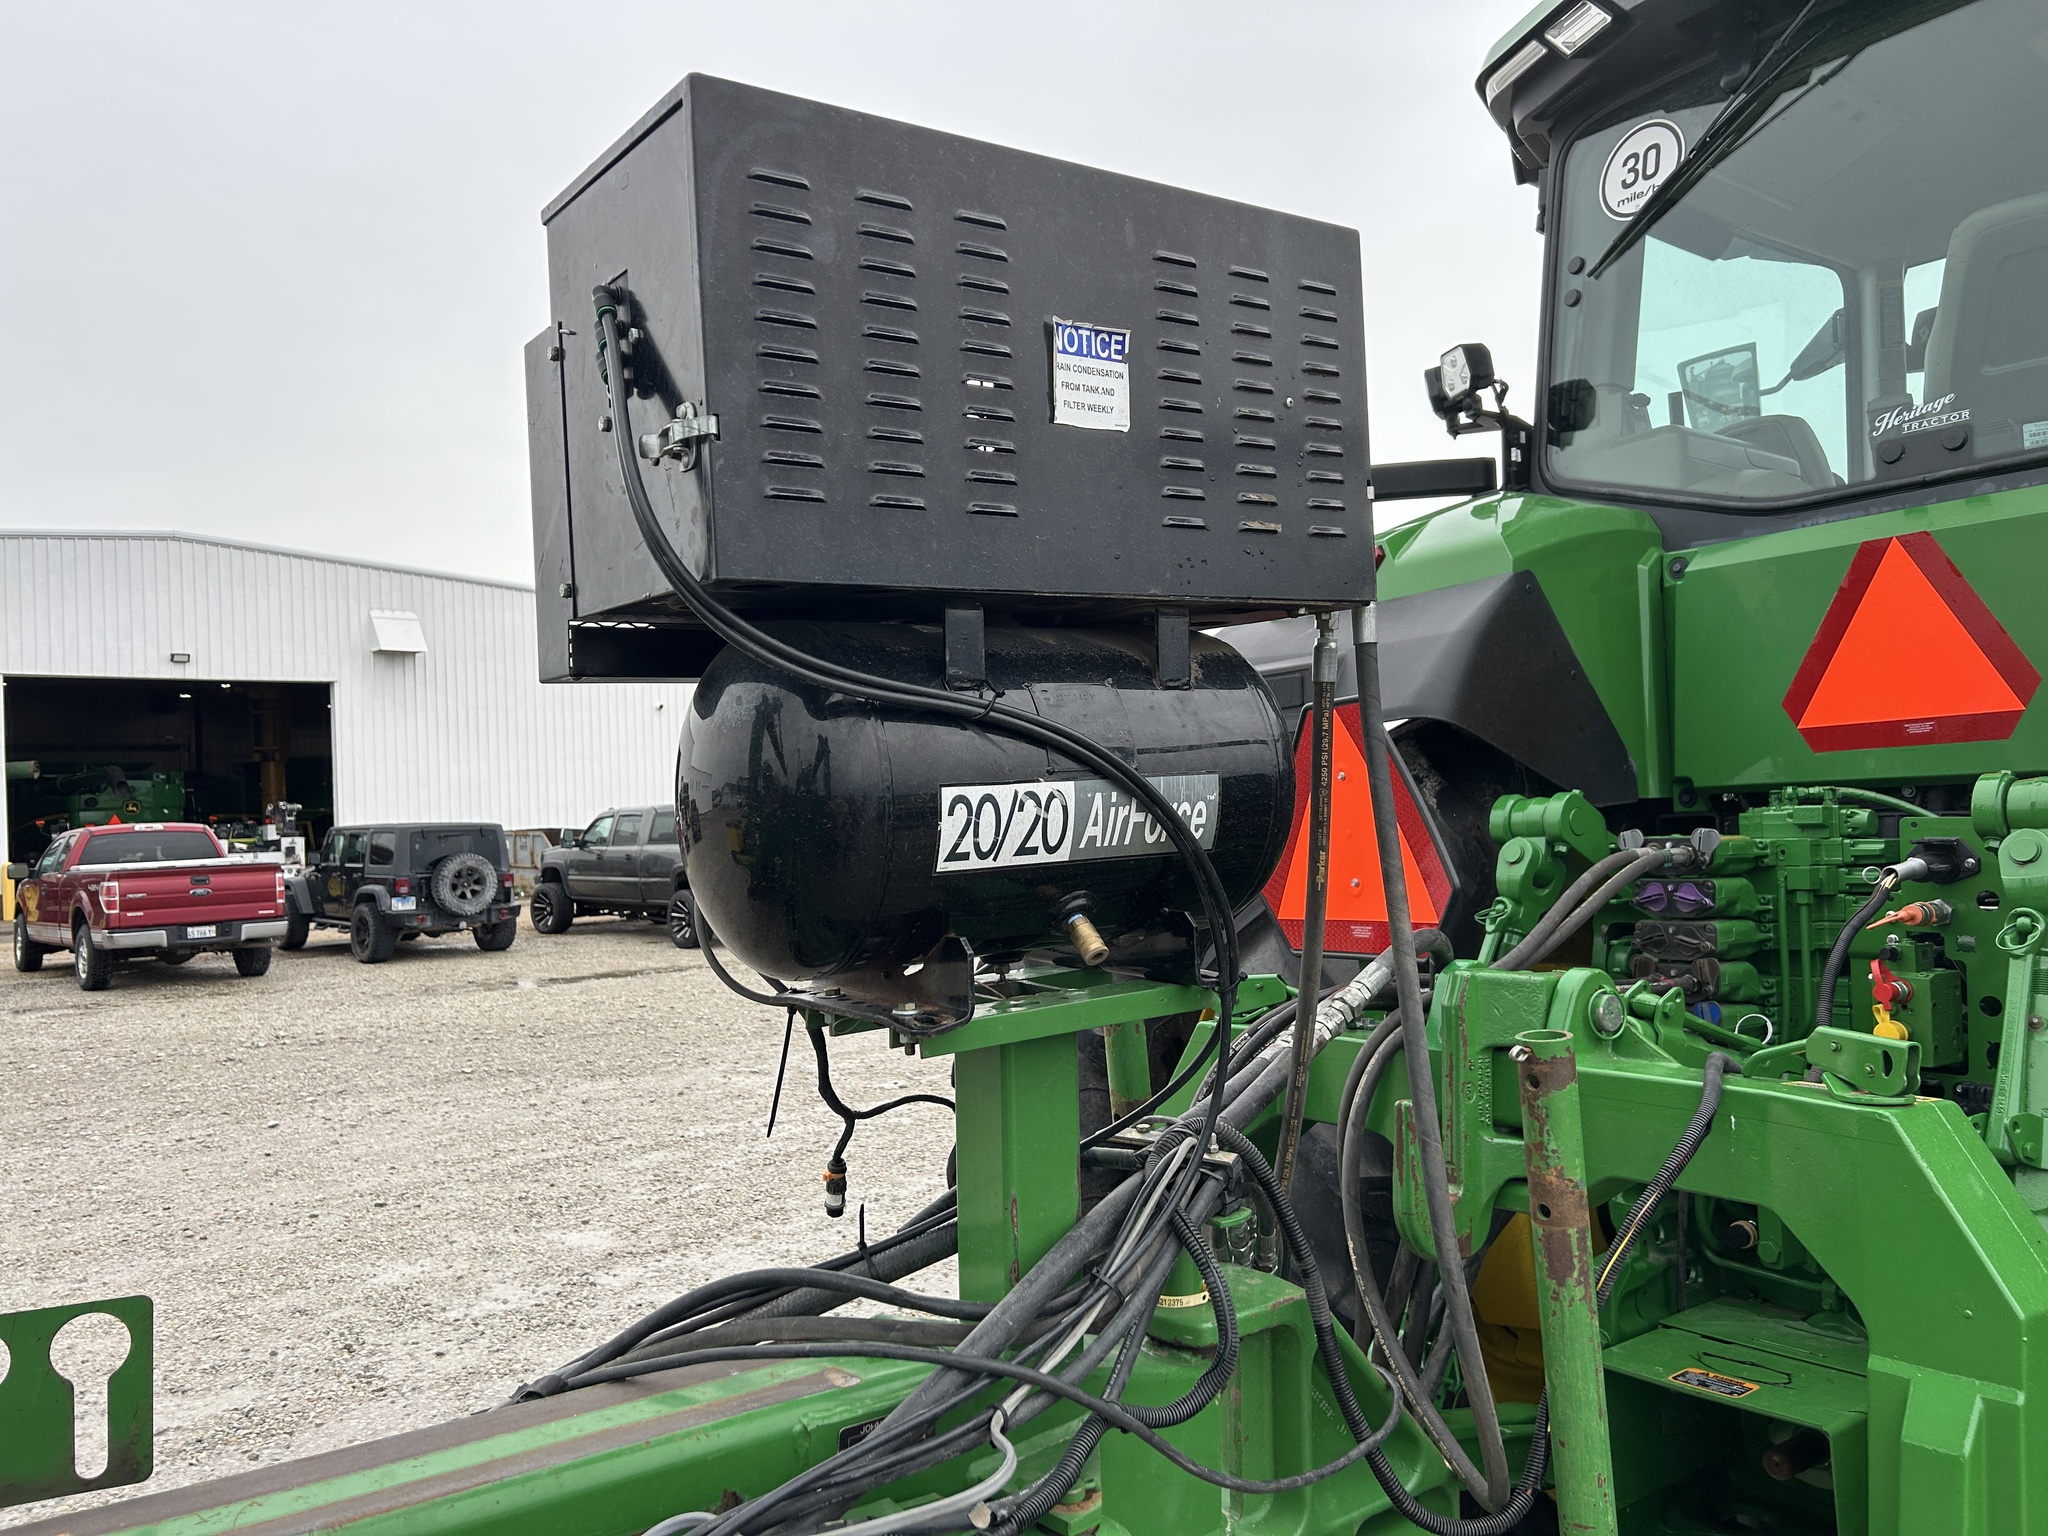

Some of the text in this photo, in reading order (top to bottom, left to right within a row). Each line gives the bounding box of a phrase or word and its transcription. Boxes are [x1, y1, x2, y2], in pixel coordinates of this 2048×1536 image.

[1621, 143, 1661, 189] 30
[1055, 326, 1123, 360] NOTICE
[1056, 362, 1124, 380] RAIN CONDENSATION
[1061, 380, 1115, 397] FROM TANK AND
[1063, 400, 1114, 414] FILTER WEEKLY
[1872, 392, 1957, 437] Heritage
[1902, 411, 1970, 431] TRACTOR
[1322, 709, 1330, 730] MPa)
[1321, 752, 1329, 765] PSI
[1320, 767, 1328, 786] 4250
[943, 788, 1069, 862] 20/20
